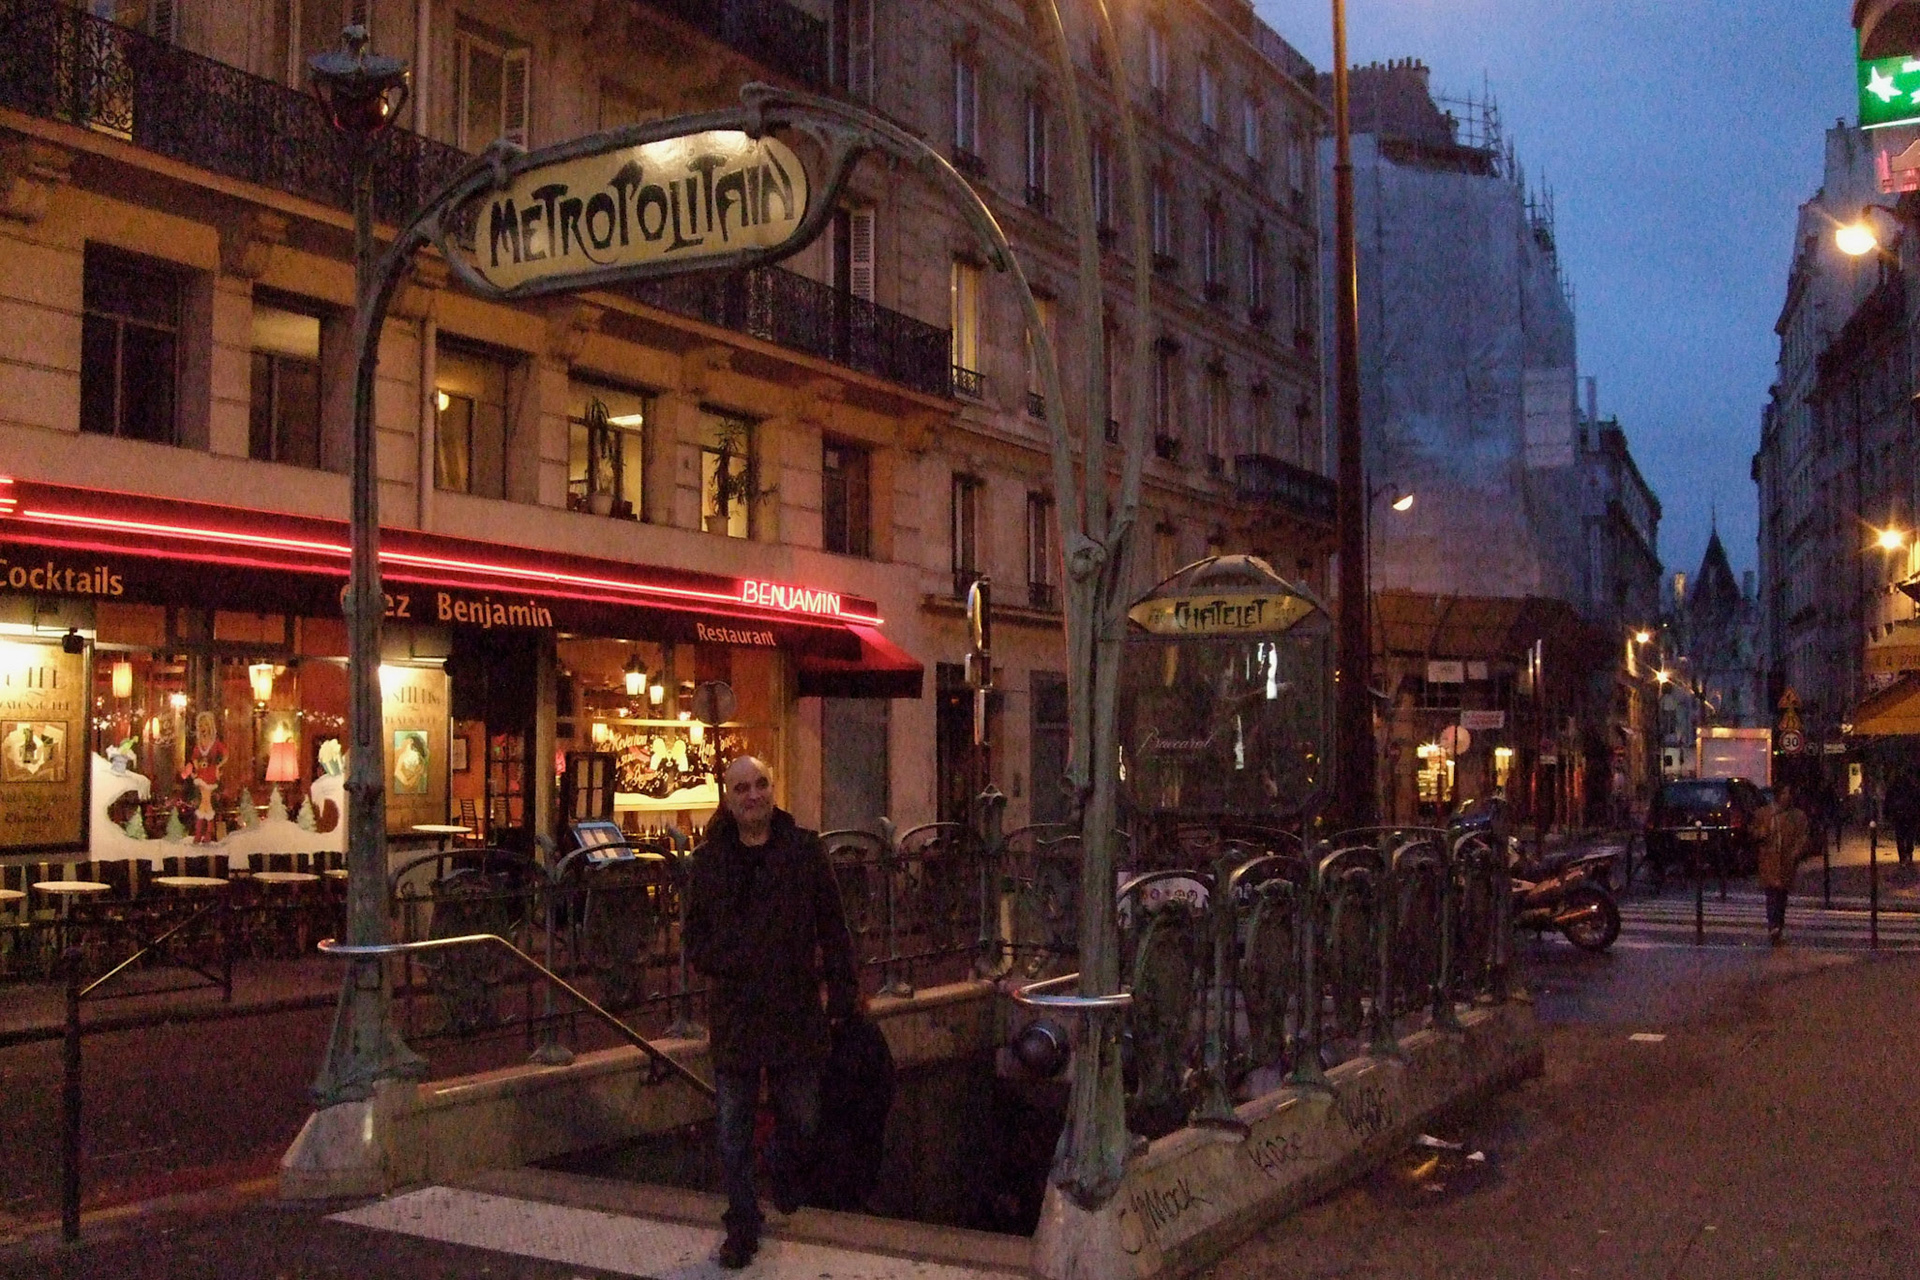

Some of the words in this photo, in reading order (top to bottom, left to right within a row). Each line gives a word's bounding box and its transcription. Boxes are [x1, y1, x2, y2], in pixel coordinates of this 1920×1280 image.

[489, 142, 795, 267] METROPOLITAIN
[340, 583, 411, 618] ez
[437, 592, 553, 629] Benjamin
[742, 580, 841, 615] BENJAMIN
[1175, 598, 1268, 630] CHATELET
[696, 622, 776, 647] Restaurant
[1785, 737, 1799, 747] 30
